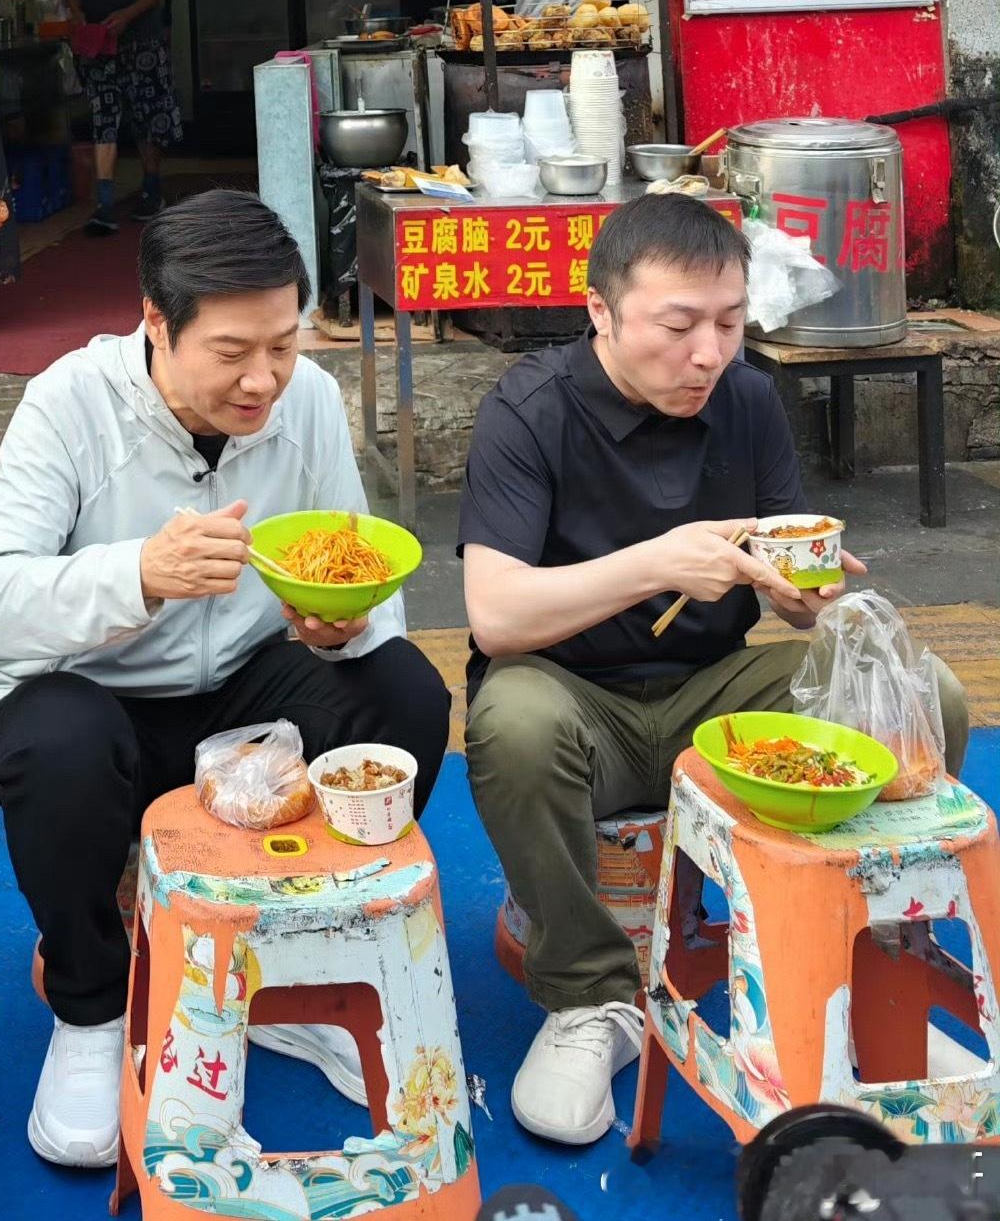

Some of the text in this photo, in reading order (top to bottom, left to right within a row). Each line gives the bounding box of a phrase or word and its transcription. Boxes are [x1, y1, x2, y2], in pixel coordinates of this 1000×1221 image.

[402, 216, 490, 255] 豆腐脑
[506, 214, 550, 251] 2元
[772, 192, 906, 273] 豆腐
[402, 261, 490, 301] 矿泉水
[507, 262, 551, 296] 2元
